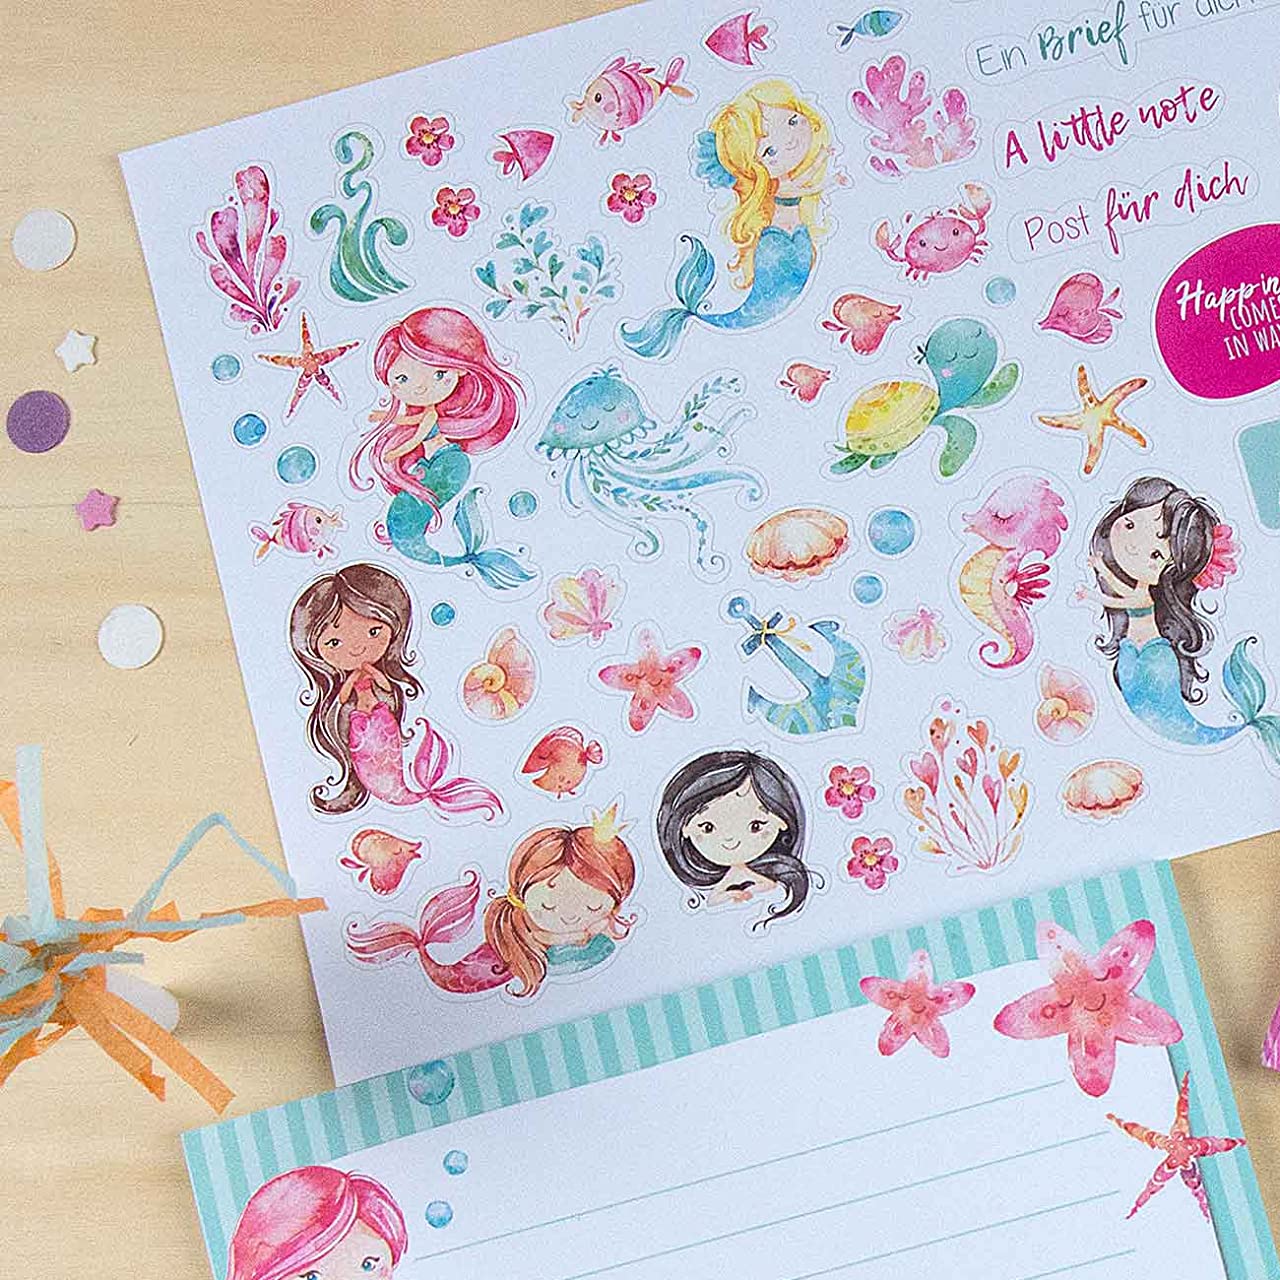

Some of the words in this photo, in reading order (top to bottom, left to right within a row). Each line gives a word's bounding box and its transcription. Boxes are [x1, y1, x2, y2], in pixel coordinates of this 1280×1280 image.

[976, 44, 1028, 76] Ein
[1037, 0, 1129, 65] Brief
[1138, 0, 1181, 32] für
[1006, 130, 1029, 169] A
[1037, 104, 1130, 163] little
[1138, 85, 1220, 130] note
[1024, 204, 1091, 251] Post
[1104, 187, 1159, 255] für
[1173, 160, 1249, 213] dich
[1223, 332, 1250, 361] IN
